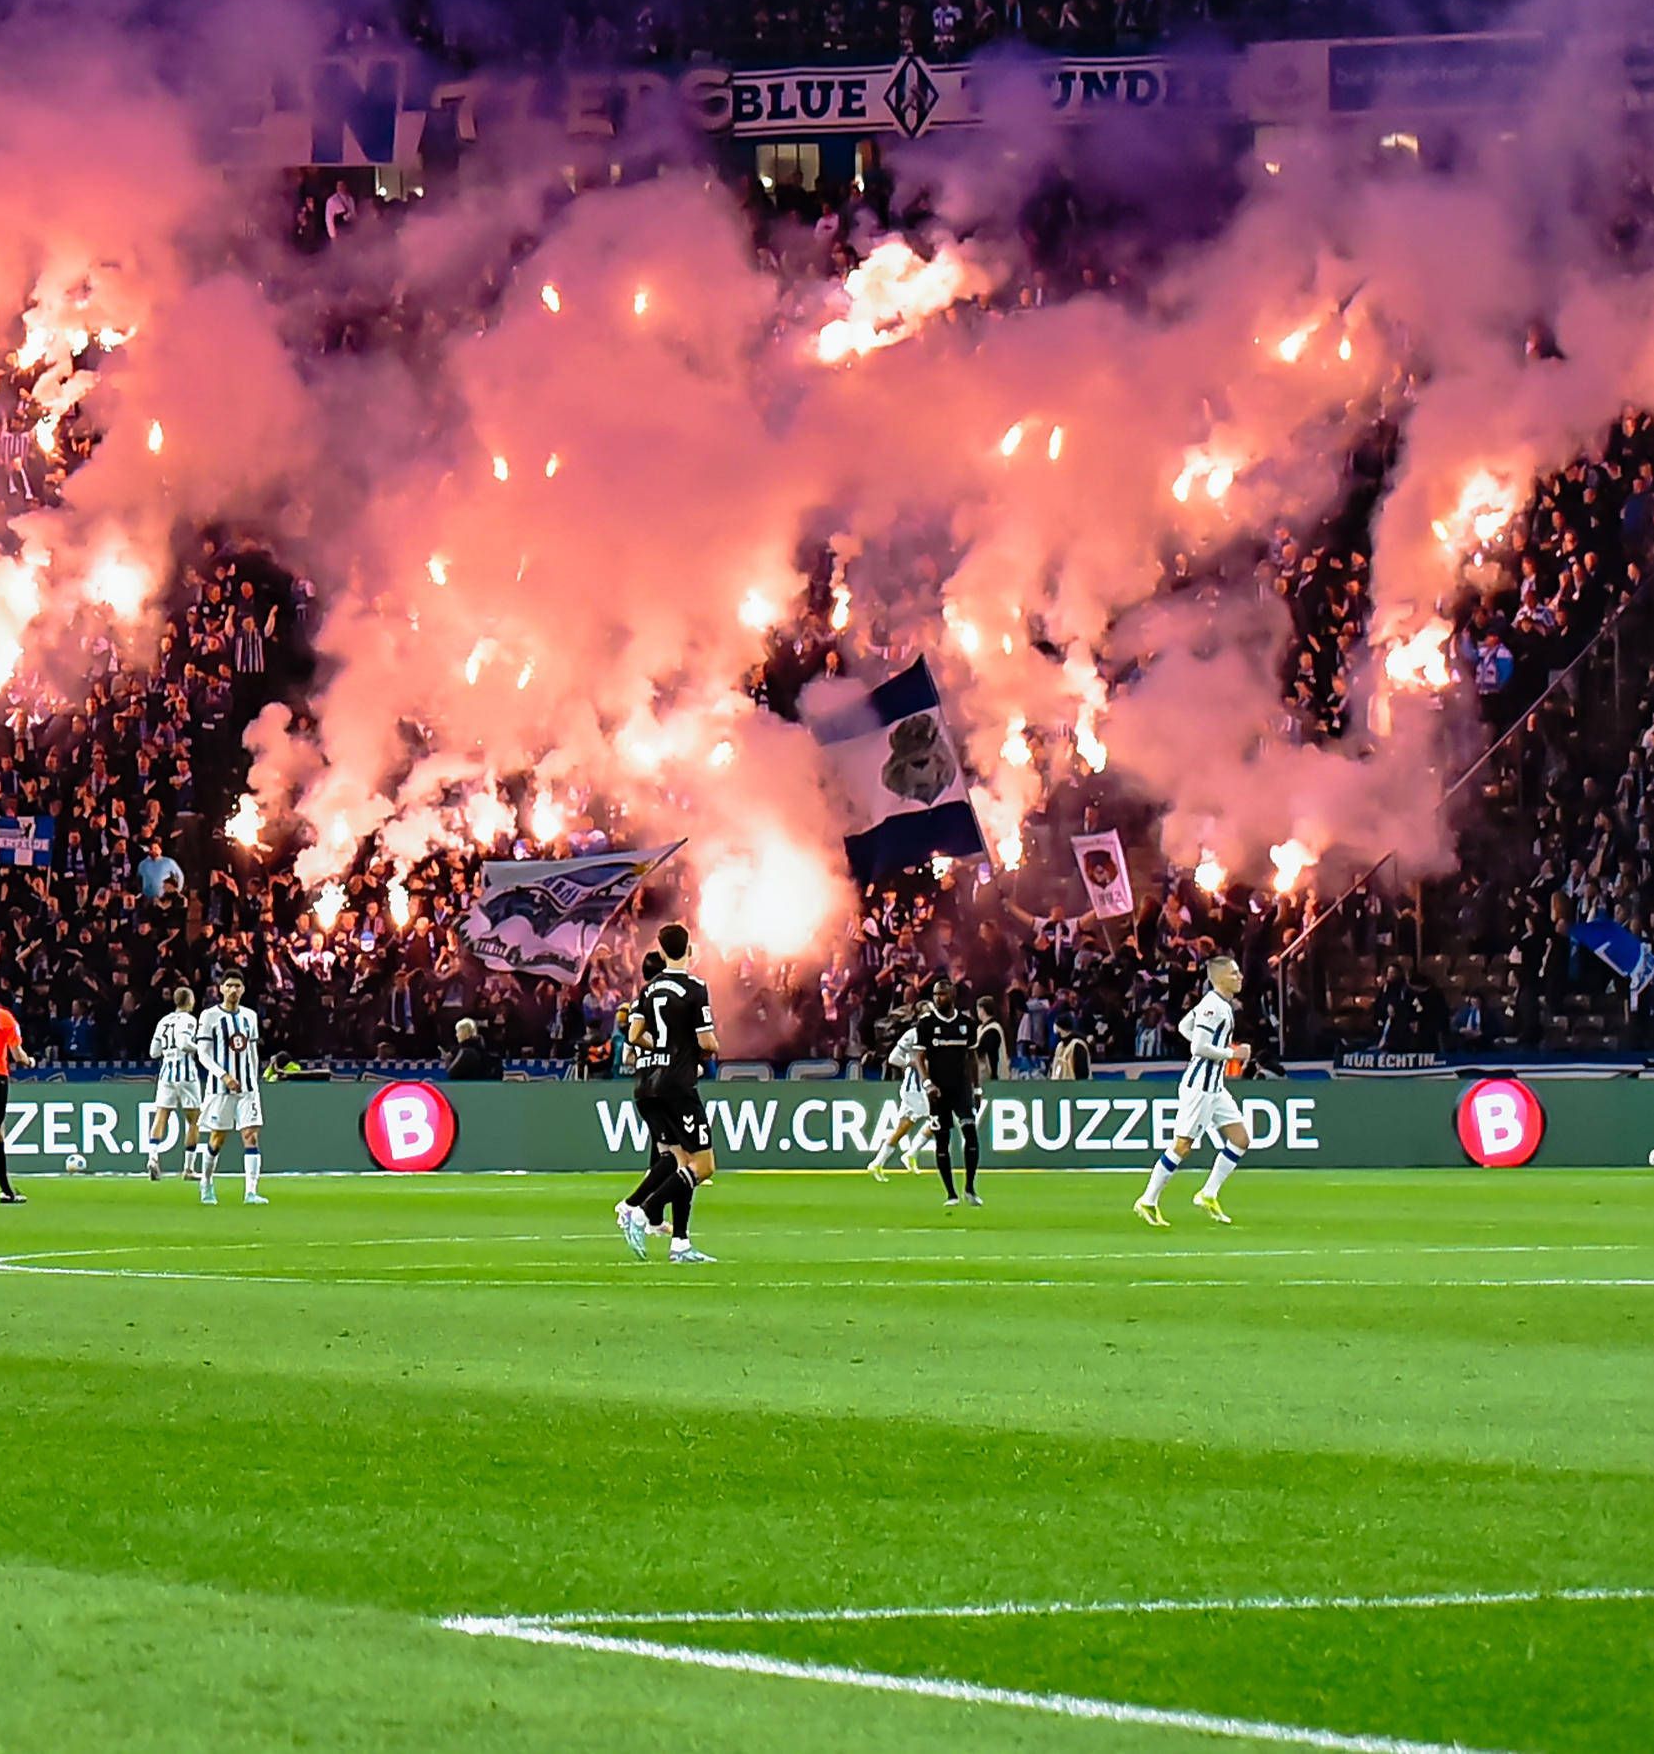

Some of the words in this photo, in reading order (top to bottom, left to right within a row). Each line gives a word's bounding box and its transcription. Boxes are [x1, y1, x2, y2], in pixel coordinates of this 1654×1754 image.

[732, 80, 868, 120] BLUE
[162, 1023, 176, 1049] 31
[1343, 1052, 1375, 1068] NUR
[1377, 1052, 1417, 1068] ECHT
[382, 1095, 435, 1160] B
[1473, 1092, 1525, 1157] B
